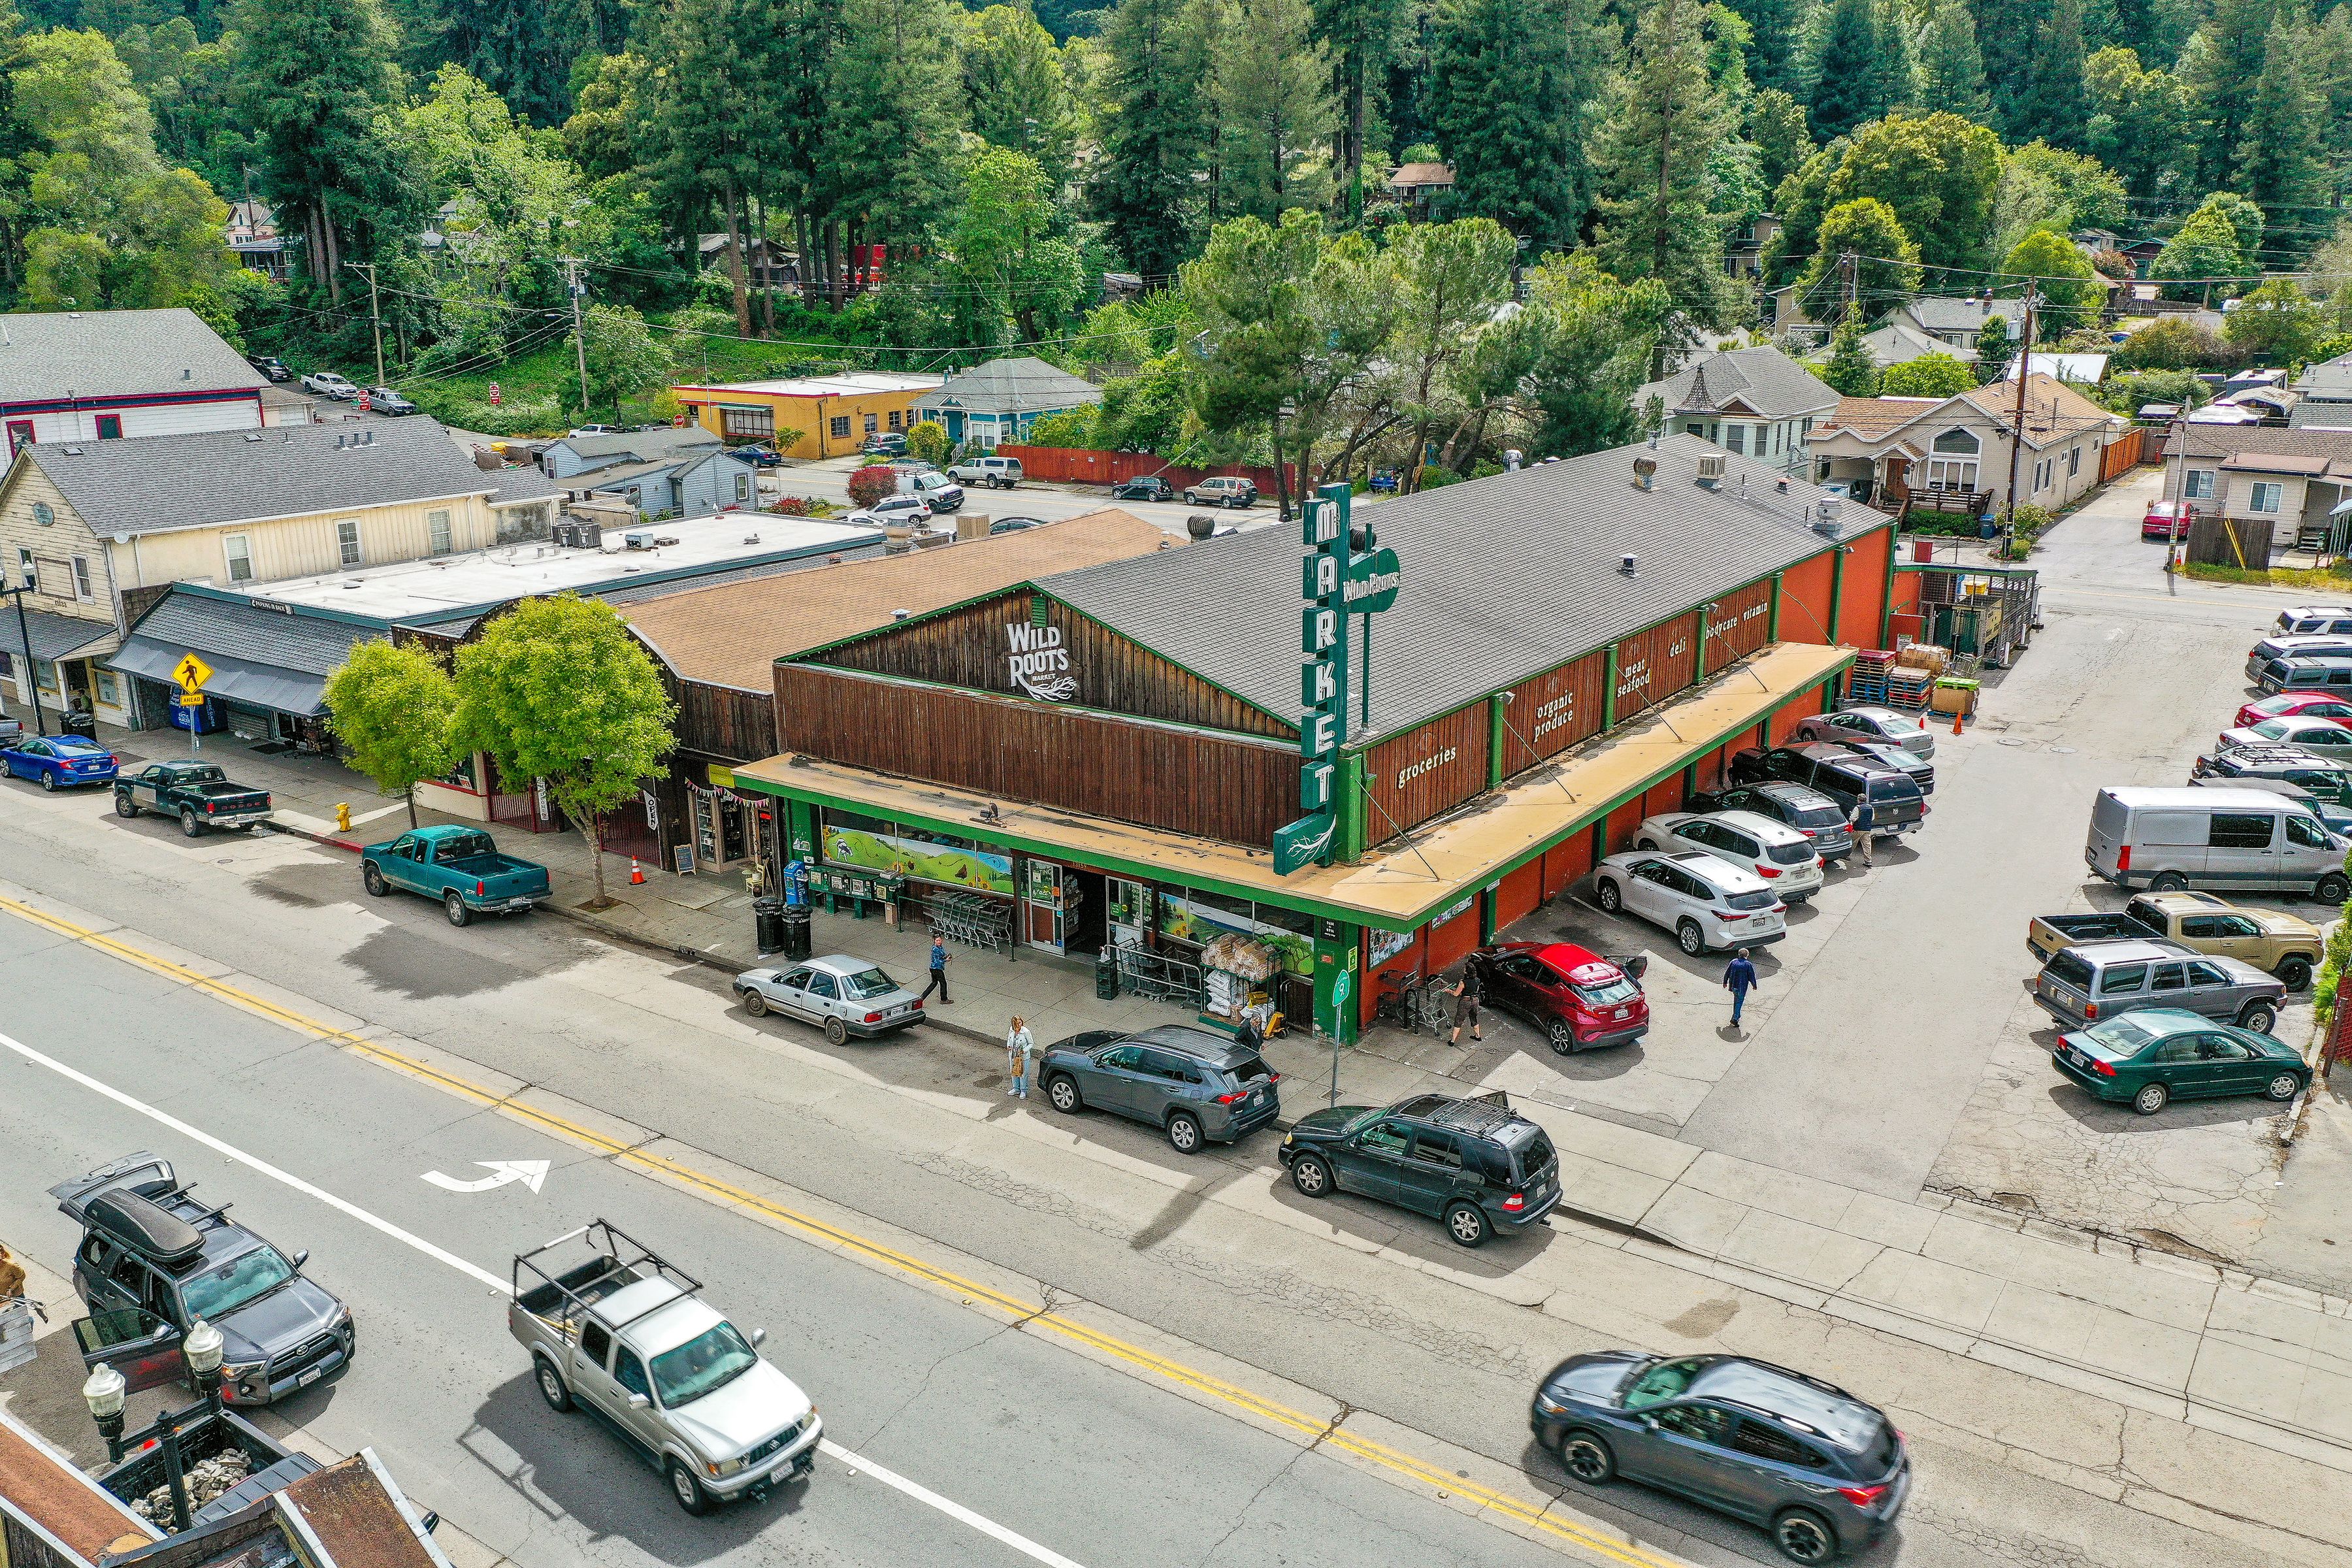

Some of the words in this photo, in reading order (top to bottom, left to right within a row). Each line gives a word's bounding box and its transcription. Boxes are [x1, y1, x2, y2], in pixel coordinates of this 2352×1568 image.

[1006, 621, 1060, 653] WILD
[1705, 616, 1737, 640] bodycare
[1315, 501, 1340, 803] MARKET
[1670, 636, 1686, 657] deli
[1008, 648, 1069, 687] ROOTS
[1032, 672, 1056, 681] MARKET
[1625, 657, 1645, 678] meat
[1617, 668, 1650, 698] seafood
[1537, 689, 1573, 719] organic
[1534, 709, 1573, 743] produce
[1398, 745, 1456, 789] groceries
[1339, 983, 1345, 996] 9
